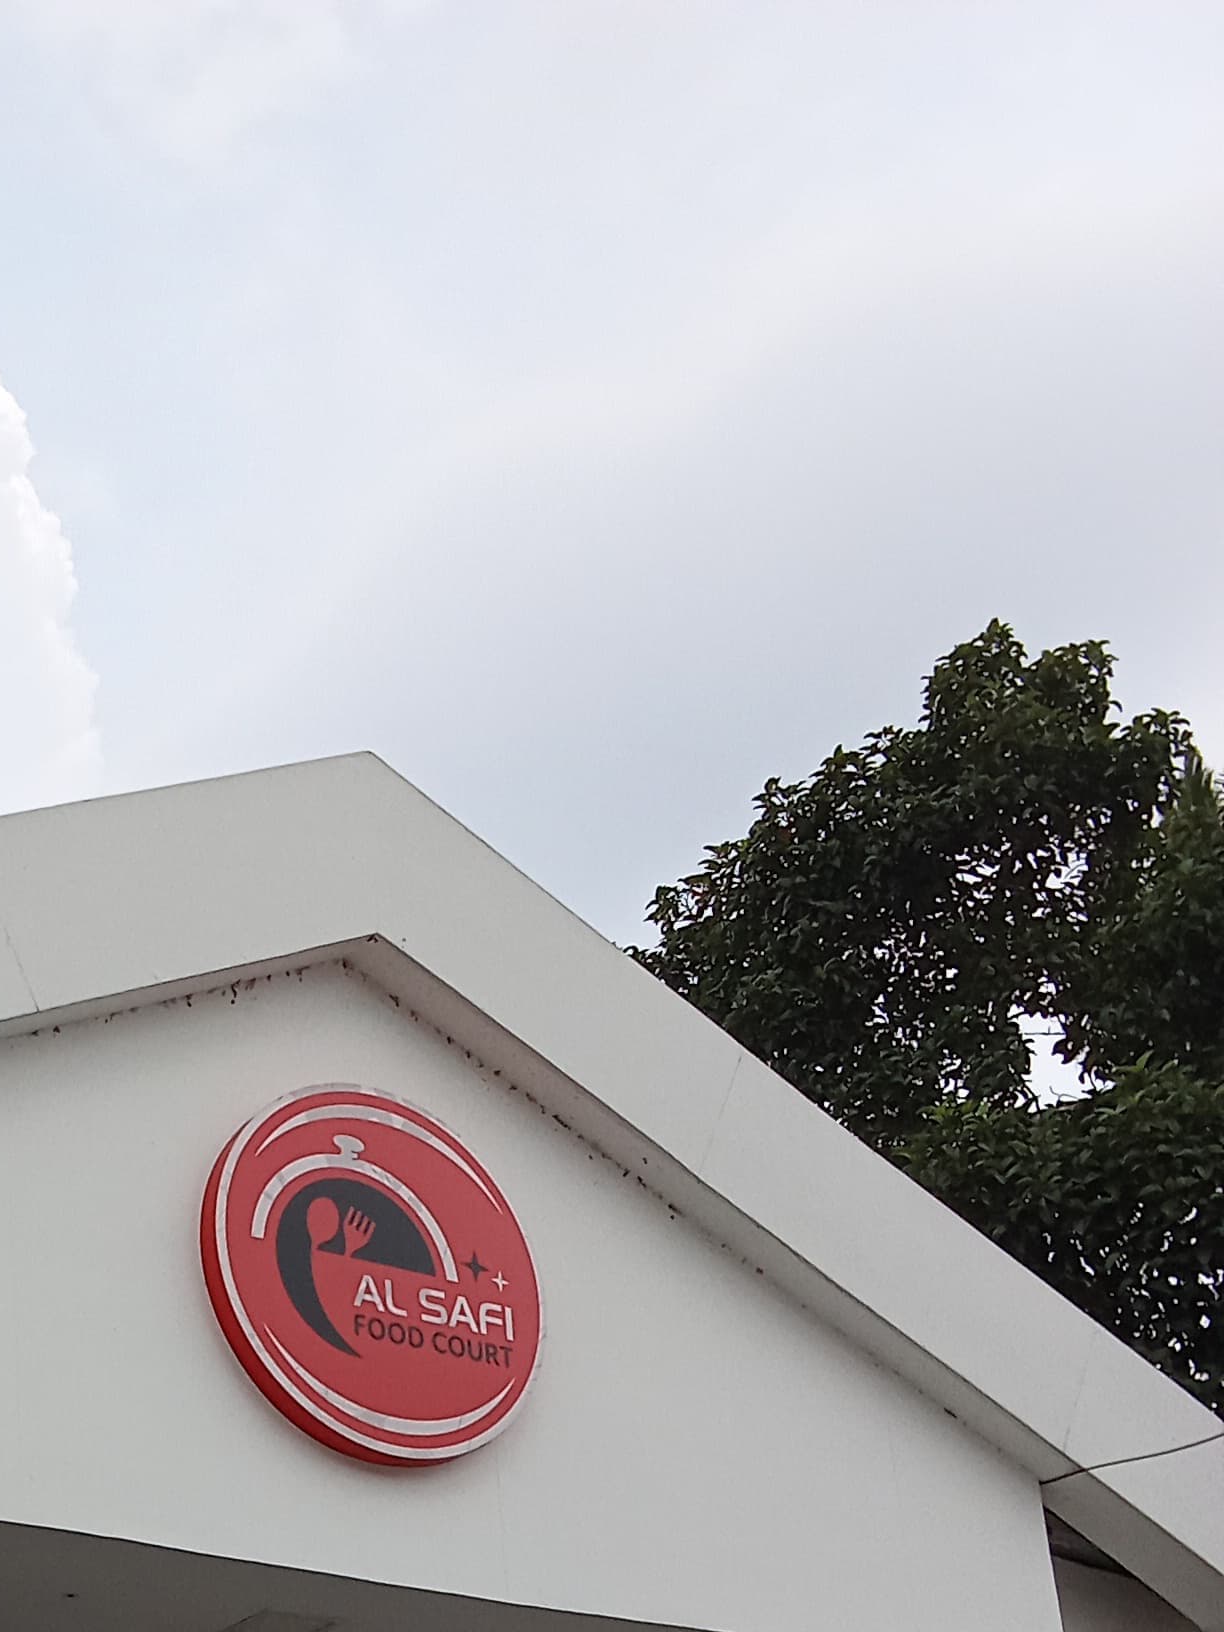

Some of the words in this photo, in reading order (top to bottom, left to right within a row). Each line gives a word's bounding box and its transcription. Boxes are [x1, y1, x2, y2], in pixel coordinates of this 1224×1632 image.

[353, 1275, 408, 1317] AL
[418, 1288, 515, 1342] SAFI
[352, 1315, 425, 1350] FOOD
[432, 1331, 513, 1369] COURT
